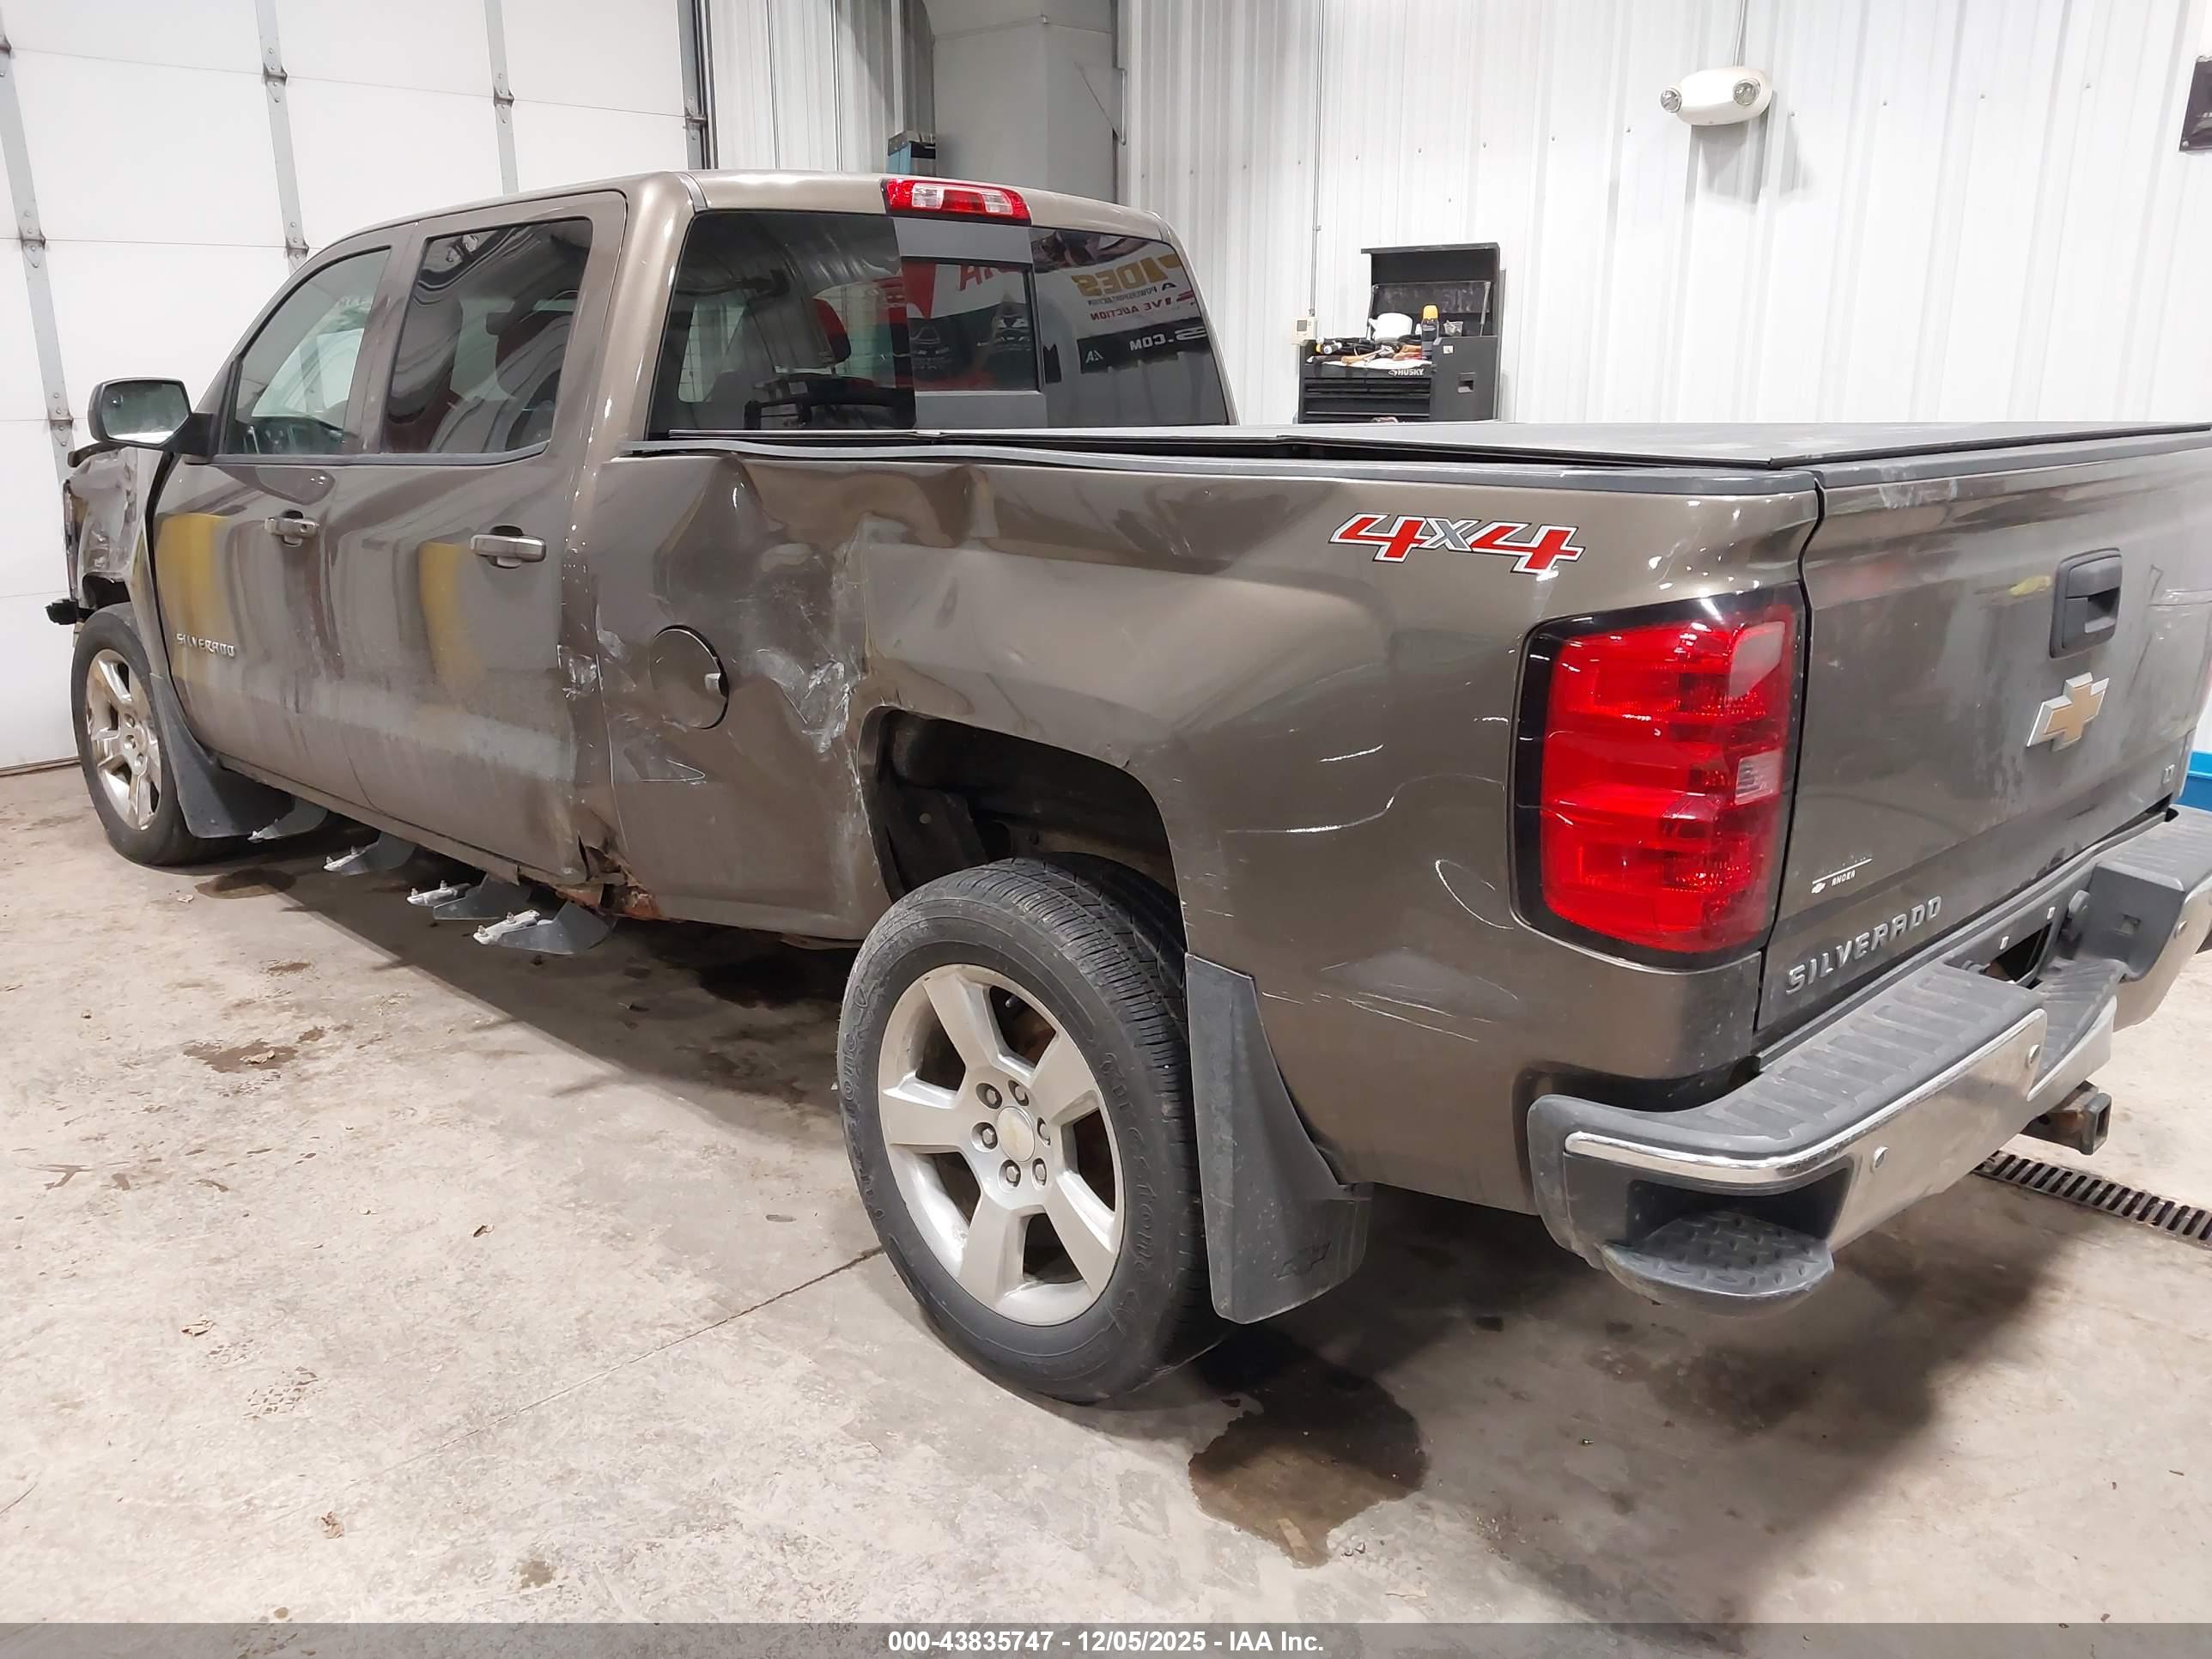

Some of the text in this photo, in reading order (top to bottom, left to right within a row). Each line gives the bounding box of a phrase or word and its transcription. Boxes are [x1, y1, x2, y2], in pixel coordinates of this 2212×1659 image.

[176, 632, 235, 657] SILVERADO
[1832, 869, 1856, 886] ANOKA
[1785, 896, 1942, 995] SILVERADO
